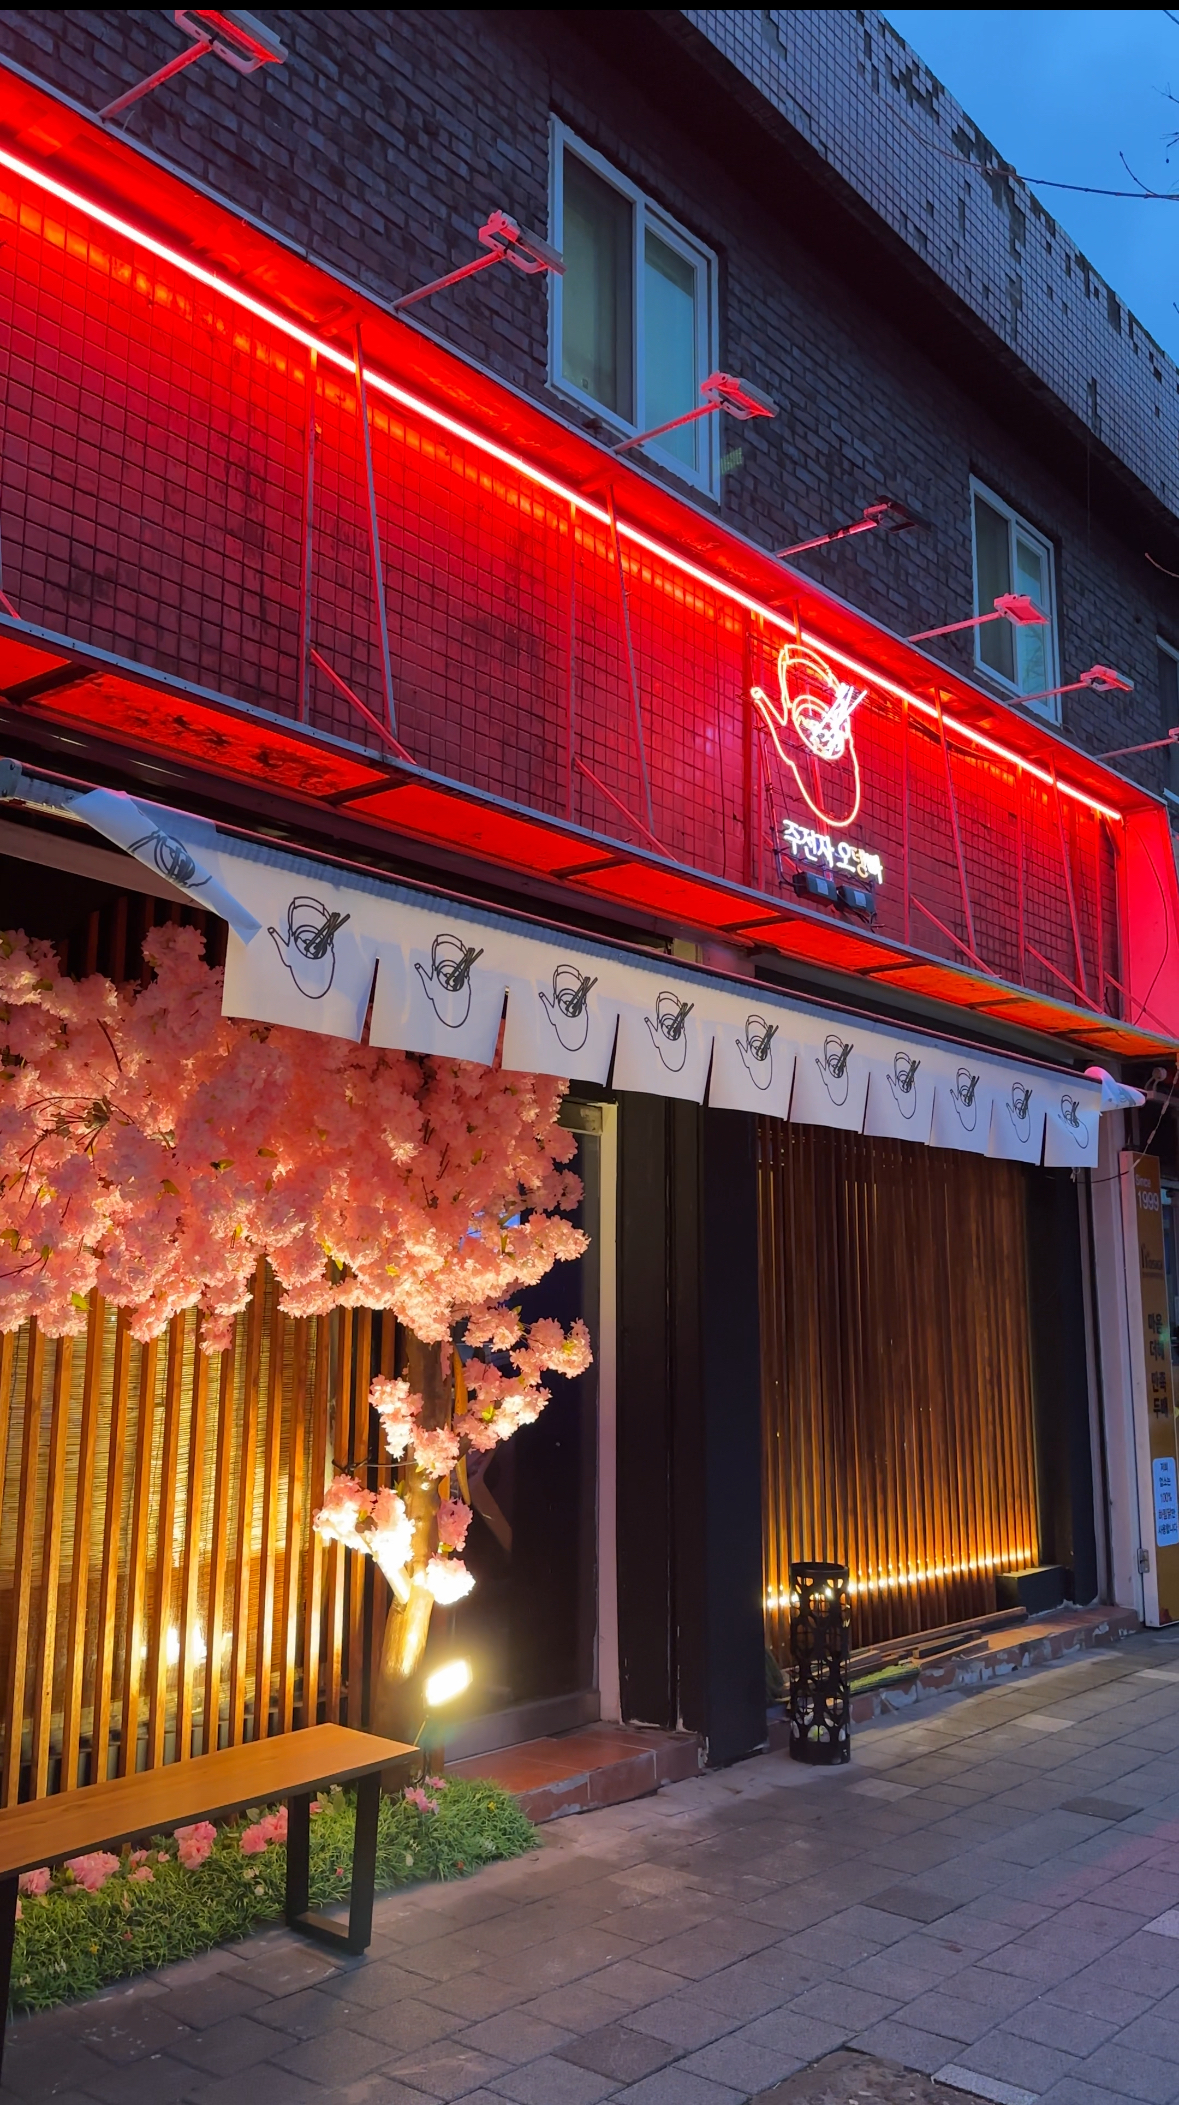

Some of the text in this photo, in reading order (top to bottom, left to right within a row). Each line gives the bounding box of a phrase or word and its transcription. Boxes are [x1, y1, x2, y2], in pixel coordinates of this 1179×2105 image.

[783, 819, 835, 867] 주전자
[1138, 1191, 1159, 1211] 1999
[1148, 1313, 1163, 1334] 마음
[1152, 1371, 1166, 1393] 만족
[1154, 1397, 1168, 1419] 두배
[1160, 1492, 1172, 1503] 100%
[1158, 1524, 1177, 1535] 사용합니다
